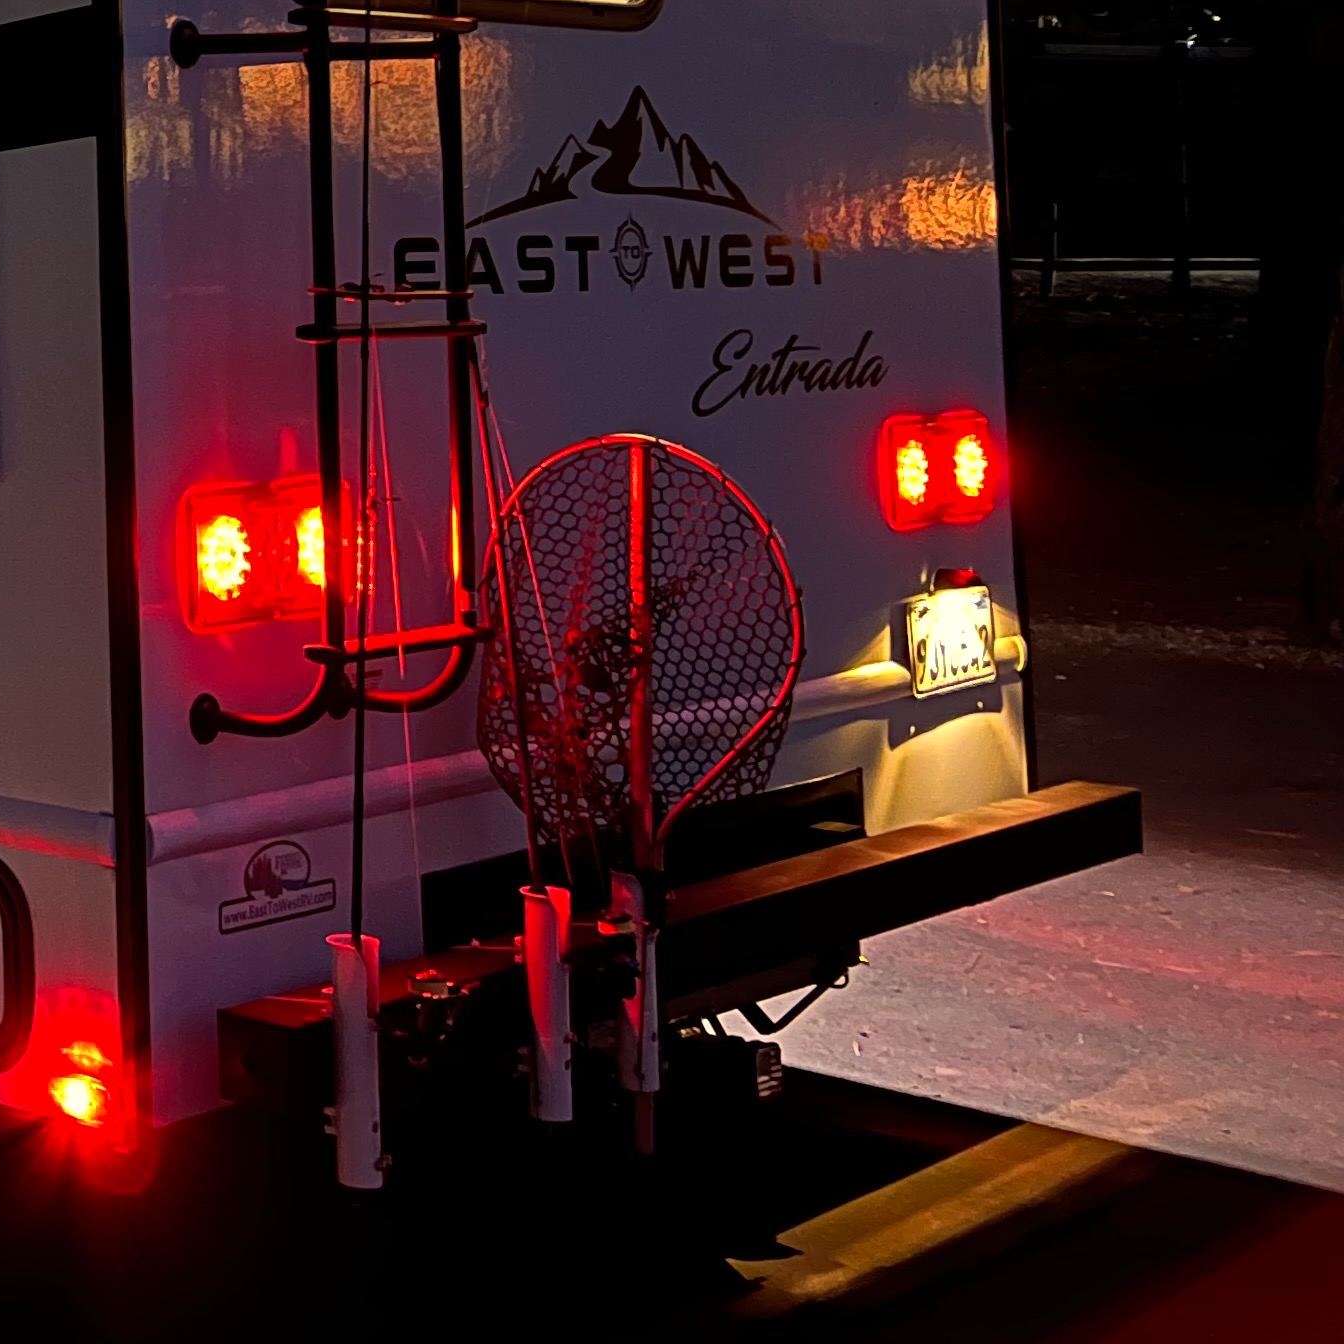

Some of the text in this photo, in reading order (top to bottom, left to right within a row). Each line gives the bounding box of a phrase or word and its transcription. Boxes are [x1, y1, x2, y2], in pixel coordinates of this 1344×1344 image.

[393, 234, 600, 294] EAST
[663, 233, 830, 290] WEST
[691, 328, 891, 418] Entrada
